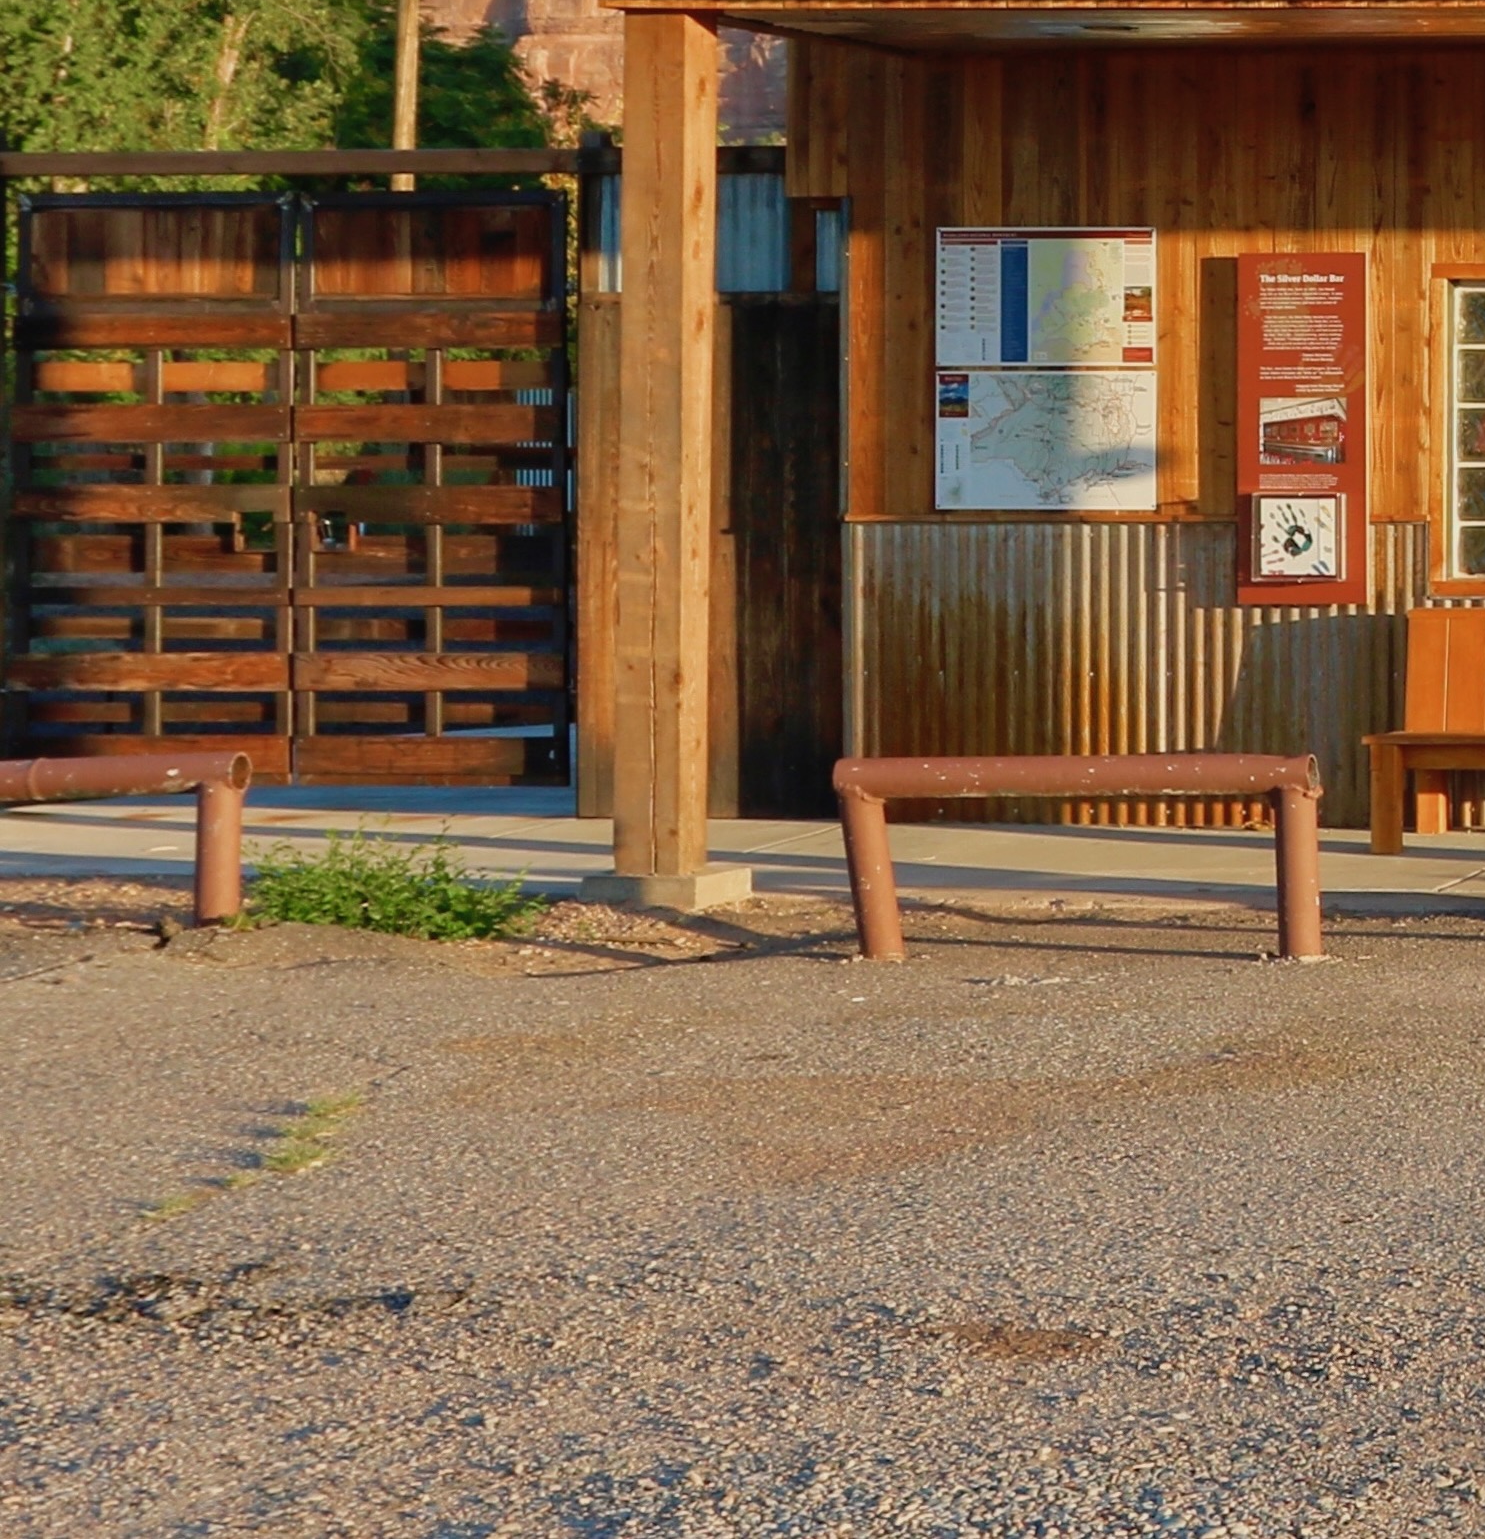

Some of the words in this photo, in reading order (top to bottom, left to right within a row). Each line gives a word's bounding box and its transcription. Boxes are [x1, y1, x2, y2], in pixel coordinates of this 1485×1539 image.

[1260, 274, 1276, 283] The
[1277, 274, 1301, 283] Silver
[1302, 274, 1328, 283] Dollar
[1329, 274, 1344, 283] Bar
